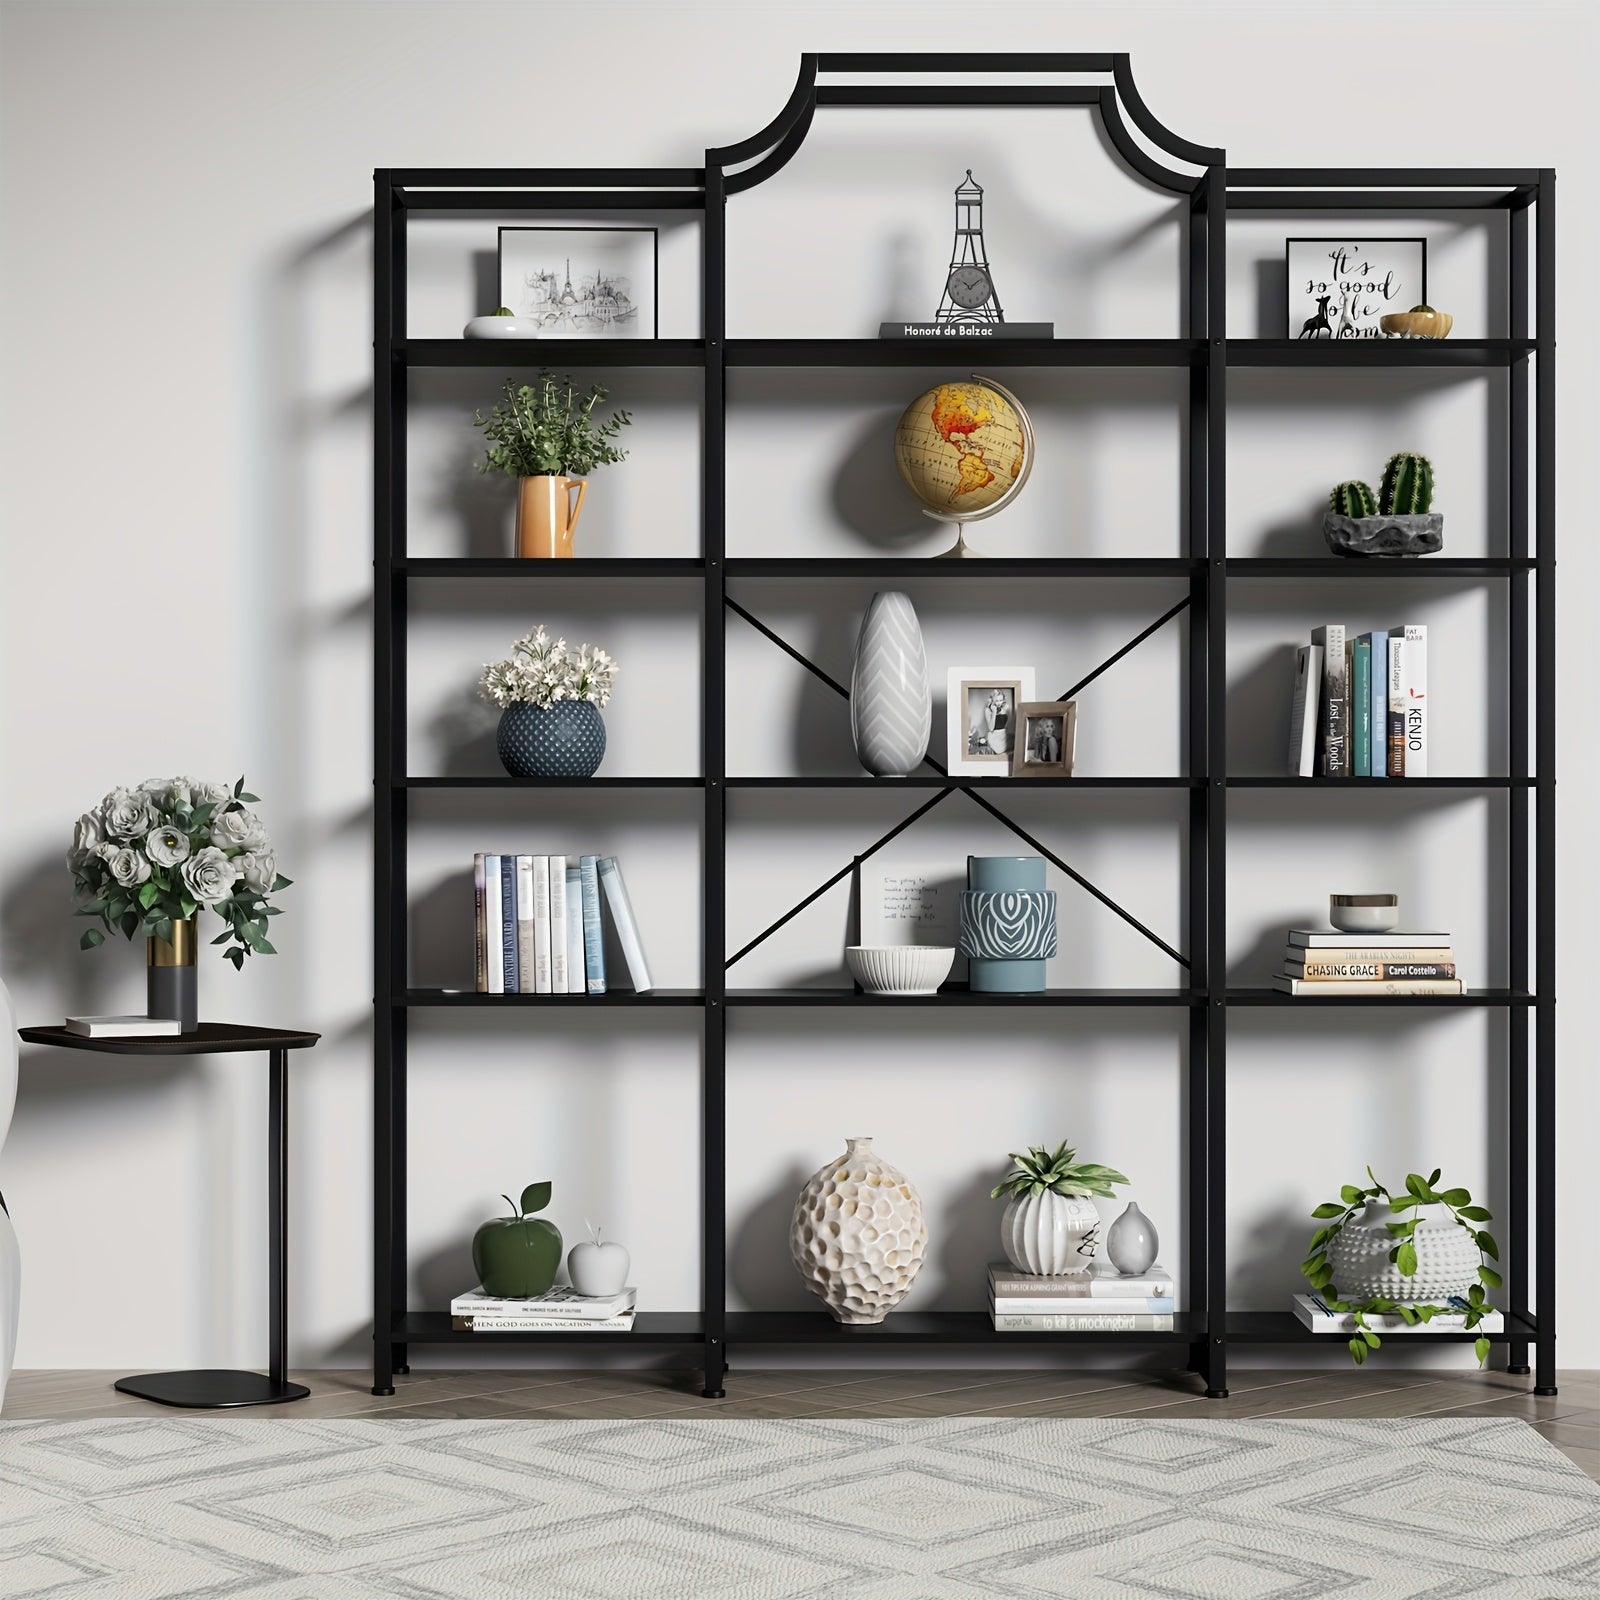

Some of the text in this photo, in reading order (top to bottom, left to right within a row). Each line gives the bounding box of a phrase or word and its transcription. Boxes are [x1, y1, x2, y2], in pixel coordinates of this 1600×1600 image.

[1329, 246, 1375, 281] It's
[1306, 270, 1402, 306] so good
[904, 324, 993, 336] Honoré de Balzac
[1393, 642, 1402, 668] Thousand
[1392, 669, 1402, 691] Leagues
[1329, 698, 1344, 720] Lost
[1408, 708, 1422, 751] KENJO
[1329, 735, 1344, 771] Woods
[503, 922, 514, 949] INWARD
[1345, 951, 1416, 960] THE ARABIAN NIGHTS
[504, 951, 515, 989] ADVENTURE
[1307, 965, 1379, 976] CHASING GRACE
[1389, 965, 1437, 976] Carol Costello
[1042, 1315, 1135, 1331] to kill a mockingbird
